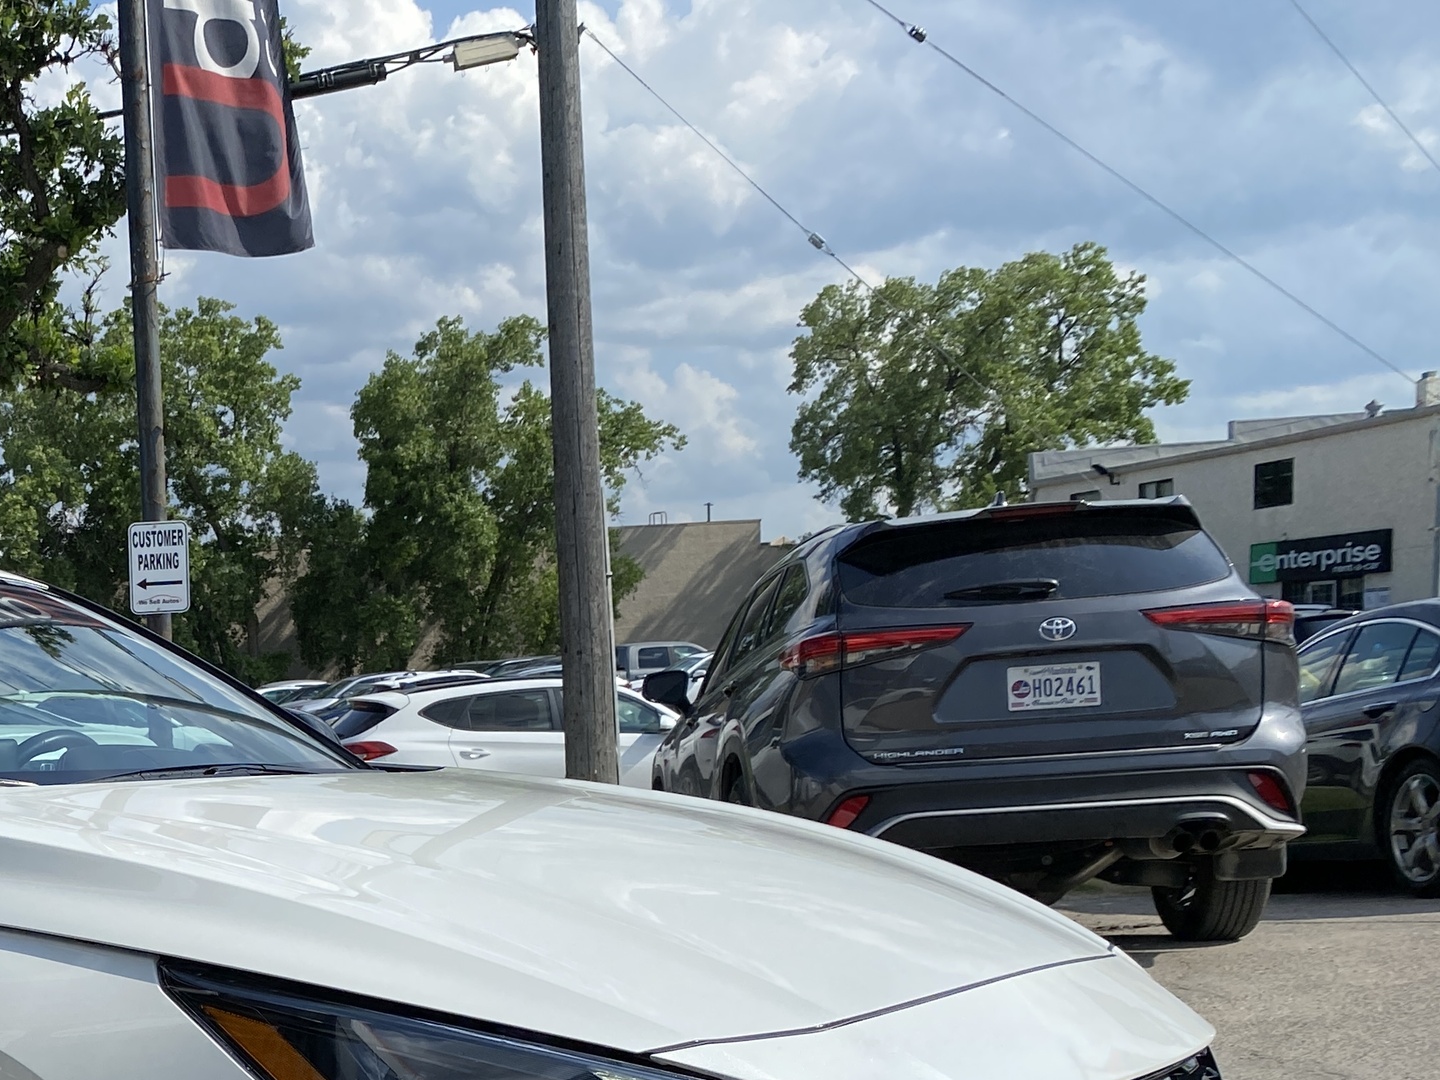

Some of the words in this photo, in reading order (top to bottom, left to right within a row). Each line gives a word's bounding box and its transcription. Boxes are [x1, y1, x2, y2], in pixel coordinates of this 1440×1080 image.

[132, 529, 184, 548] CUSTOMER
[137, 552, 180, 571] PARKING
[1253, 541, 1382, 572] enterprise
[873, 747, 964, 760] HIGHLANDER
